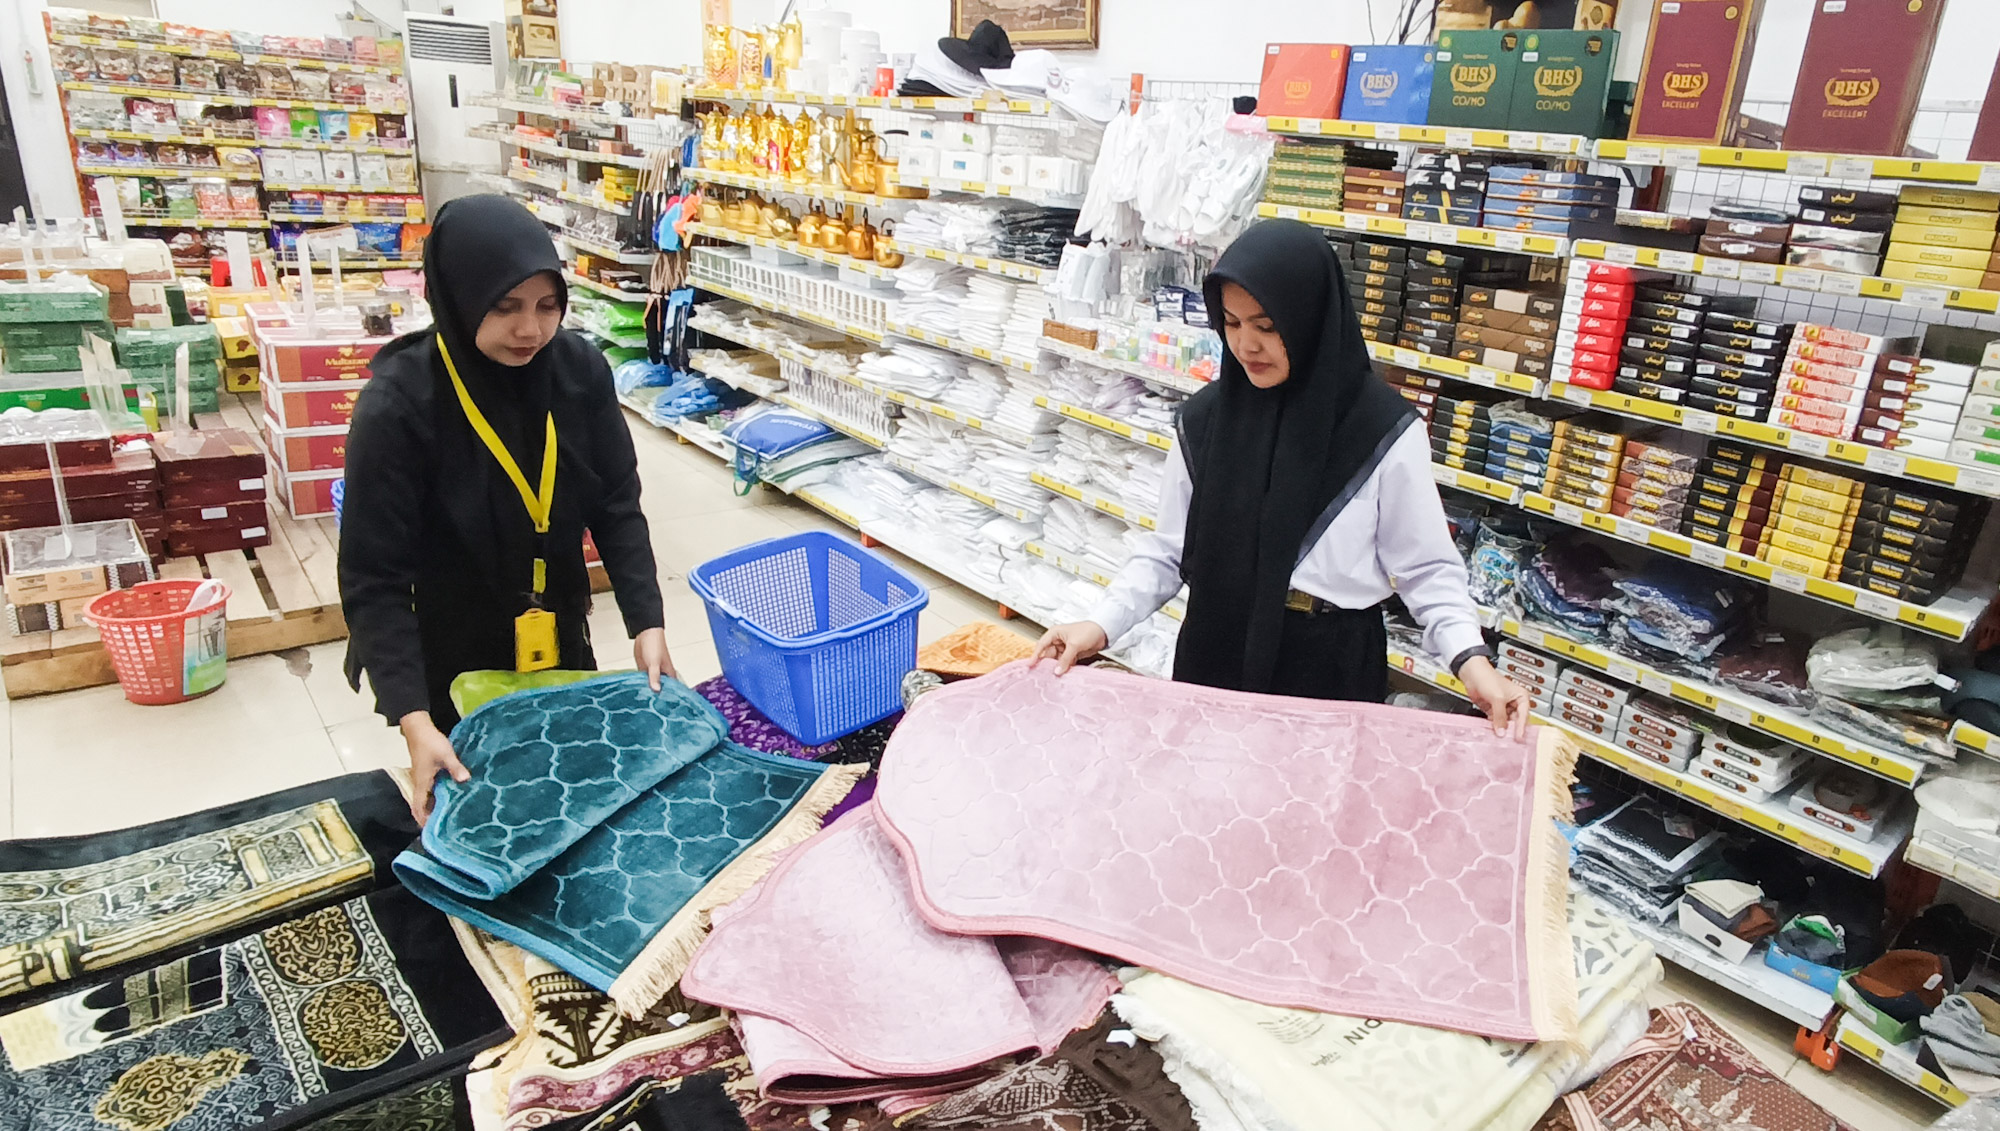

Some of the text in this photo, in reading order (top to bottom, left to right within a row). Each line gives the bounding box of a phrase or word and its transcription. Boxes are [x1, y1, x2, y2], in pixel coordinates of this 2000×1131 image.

[1366, 74, 1393, 90] BHS
[1457, 66, 1490, 83] BHS
[1541, 69, 1575, 86] BHS
[1670, 74, 1702, 89] BHS
[1833, 80, 1871, 96] BHS
[1662, 100, 1699, 109] EXCELLENT
[1822, 109, 1868, 118] EXCELLENT
